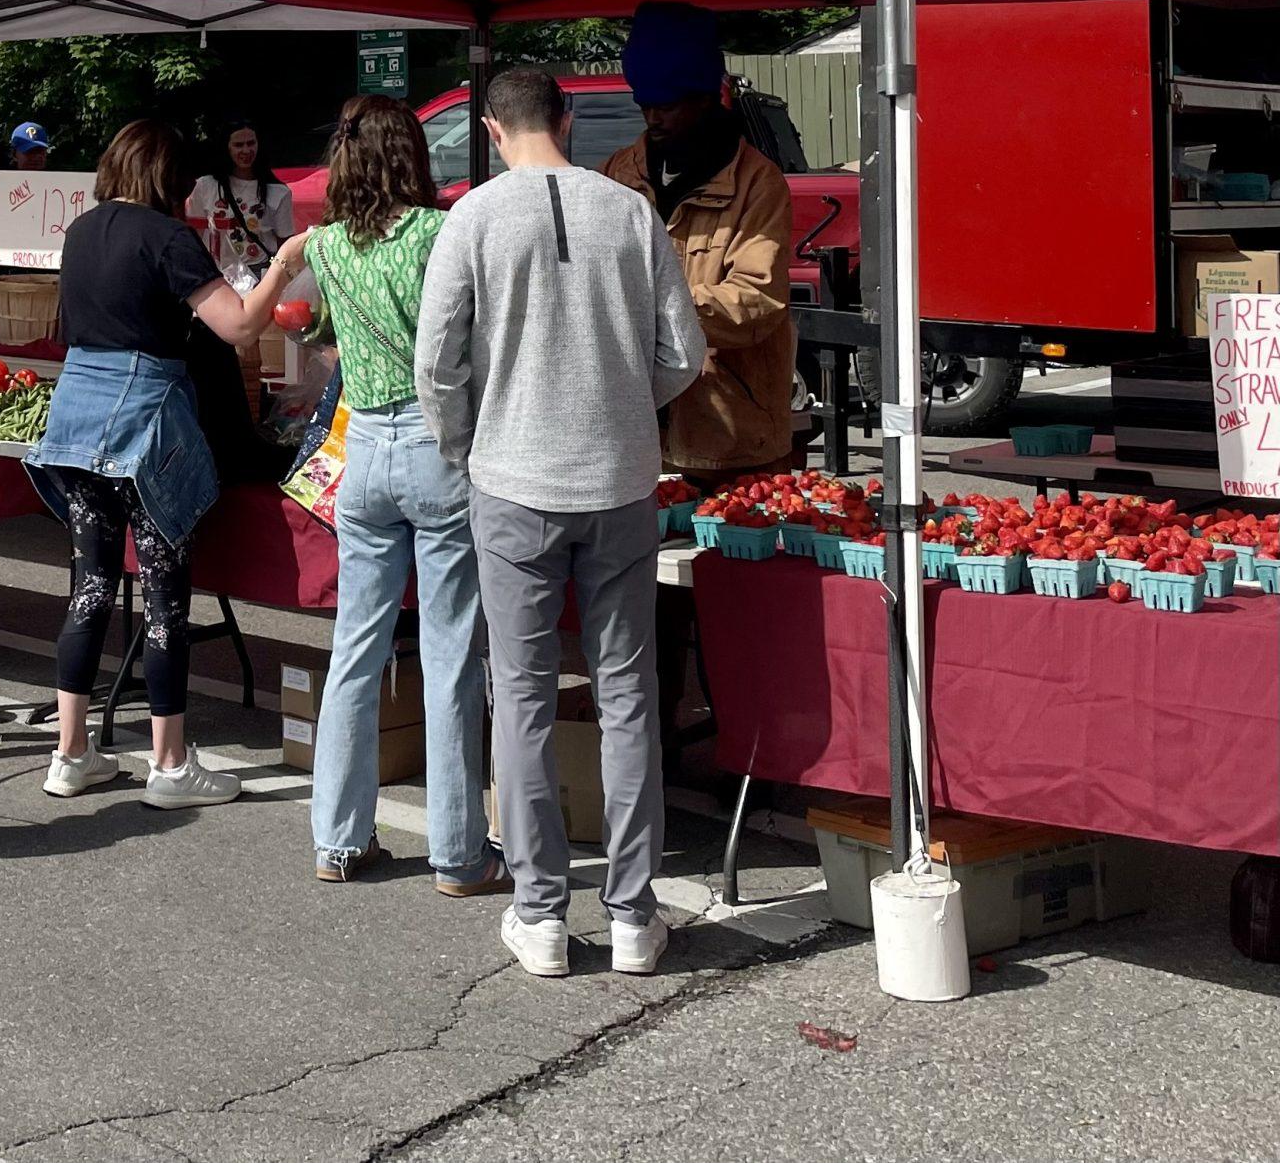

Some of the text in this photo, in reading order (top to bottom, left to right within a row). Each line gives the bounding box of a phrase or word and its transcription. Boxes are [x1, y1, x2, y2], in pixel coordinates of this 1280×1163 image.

[9, 179, 31, 206] ONLY
[13, 252, 54, 268] PRODUCT
[1218, 407, 1248, 430] ONLY
[1224, 480, 1280, 497] PRODUCT
